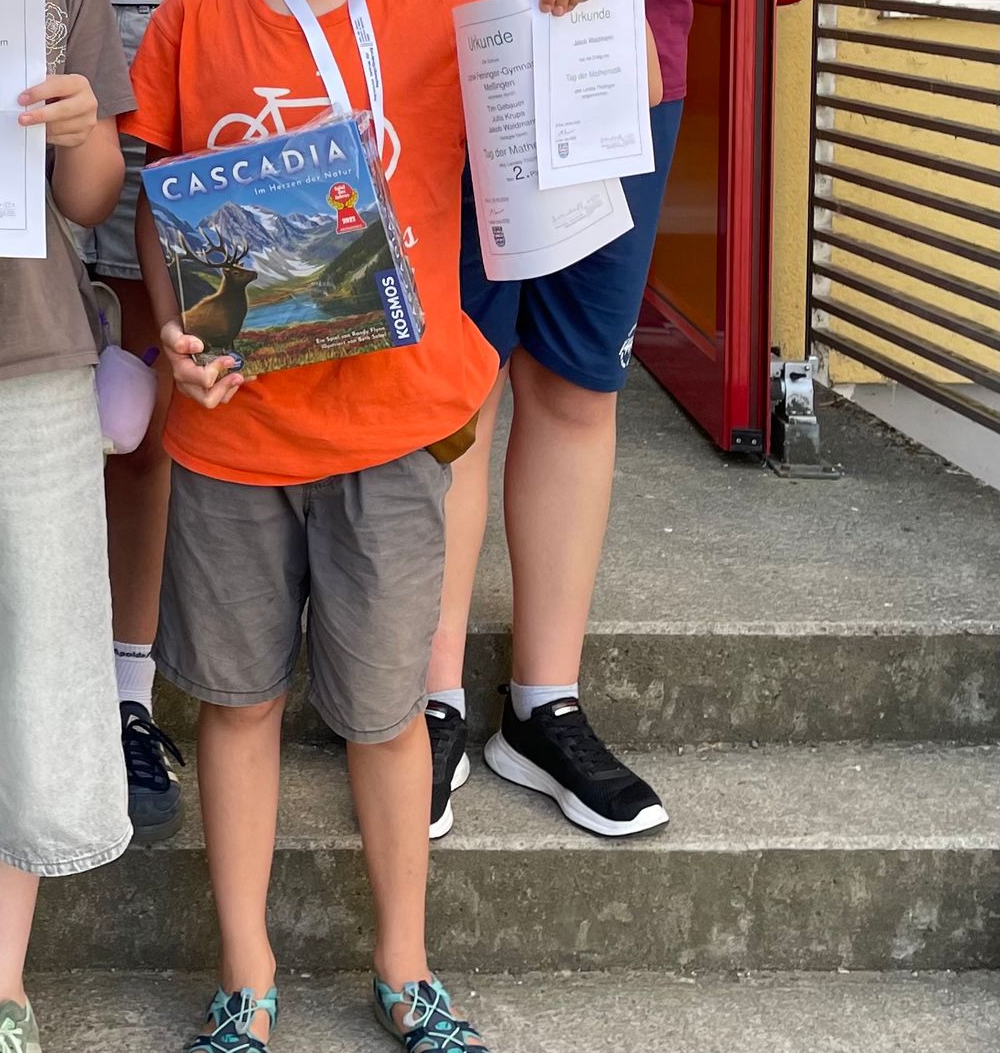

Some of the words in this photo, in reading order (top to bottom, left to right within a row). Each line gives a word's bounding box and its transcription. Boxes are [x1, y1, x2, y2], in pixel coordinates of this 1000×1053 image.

[570, 8, 611, 24] Urkunde
[162, 139, 348, 201] CASCADIA
[254, 187, 266, 196] Im
[269, 180, 302, 193] Herzen
[305, 175, 321, 184] der
[324, 168, 352, 179] Natur
[382, 276, 410, 340] KOSMOS
